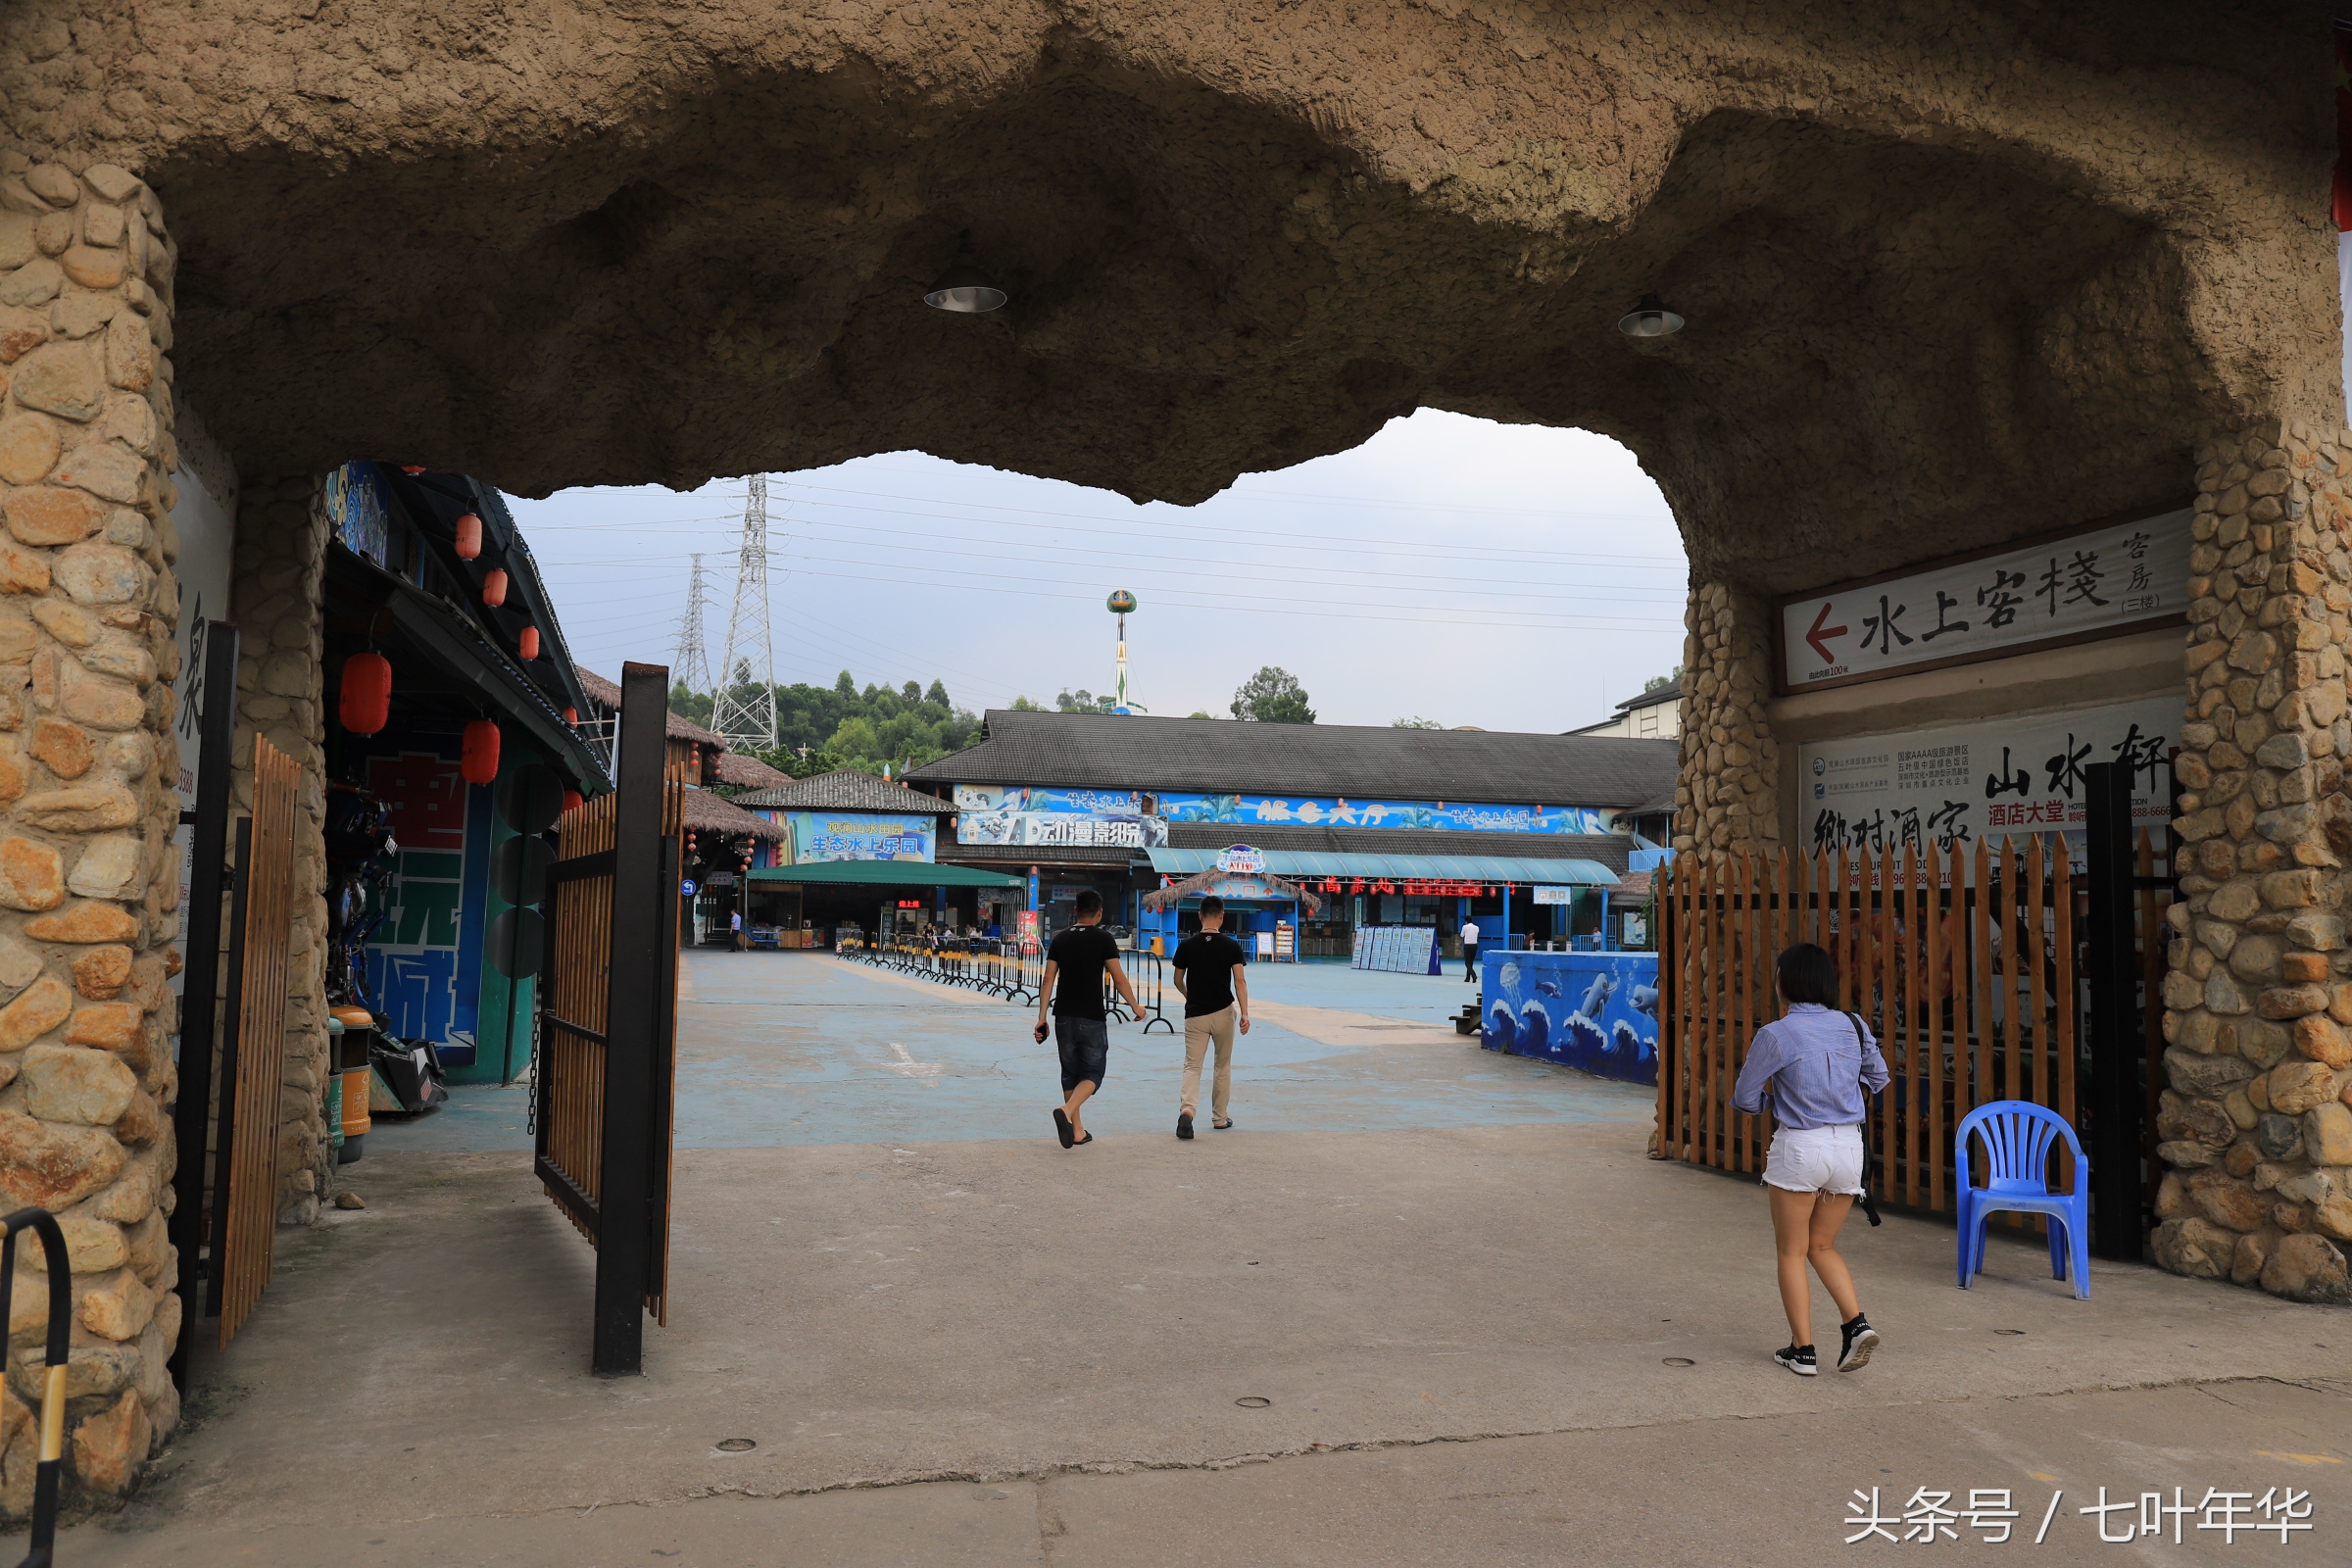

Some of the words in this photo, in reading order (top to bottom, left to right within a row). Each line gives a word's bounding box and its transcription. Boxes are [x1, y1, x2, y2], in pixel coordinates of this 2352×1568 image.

[2123, 532, 2153, 591] 客房
[2121, 594, 2160, 614] (三楼)
[1897, 745, 1969, 761] 国家AAAA级旅游景区
[1897, 757, 1969, 772] 五叶级中国绿色饭店
[1988, 800, 2065, 826] 酒店大堂
[826, 821, 905, 835] 观澜山水田园
[1004, 816, 1142, 845] 7D动漫影院
[810, 835, 918, 855] 生态水上乐园
[1222, 884, 1256, 897] 入口
